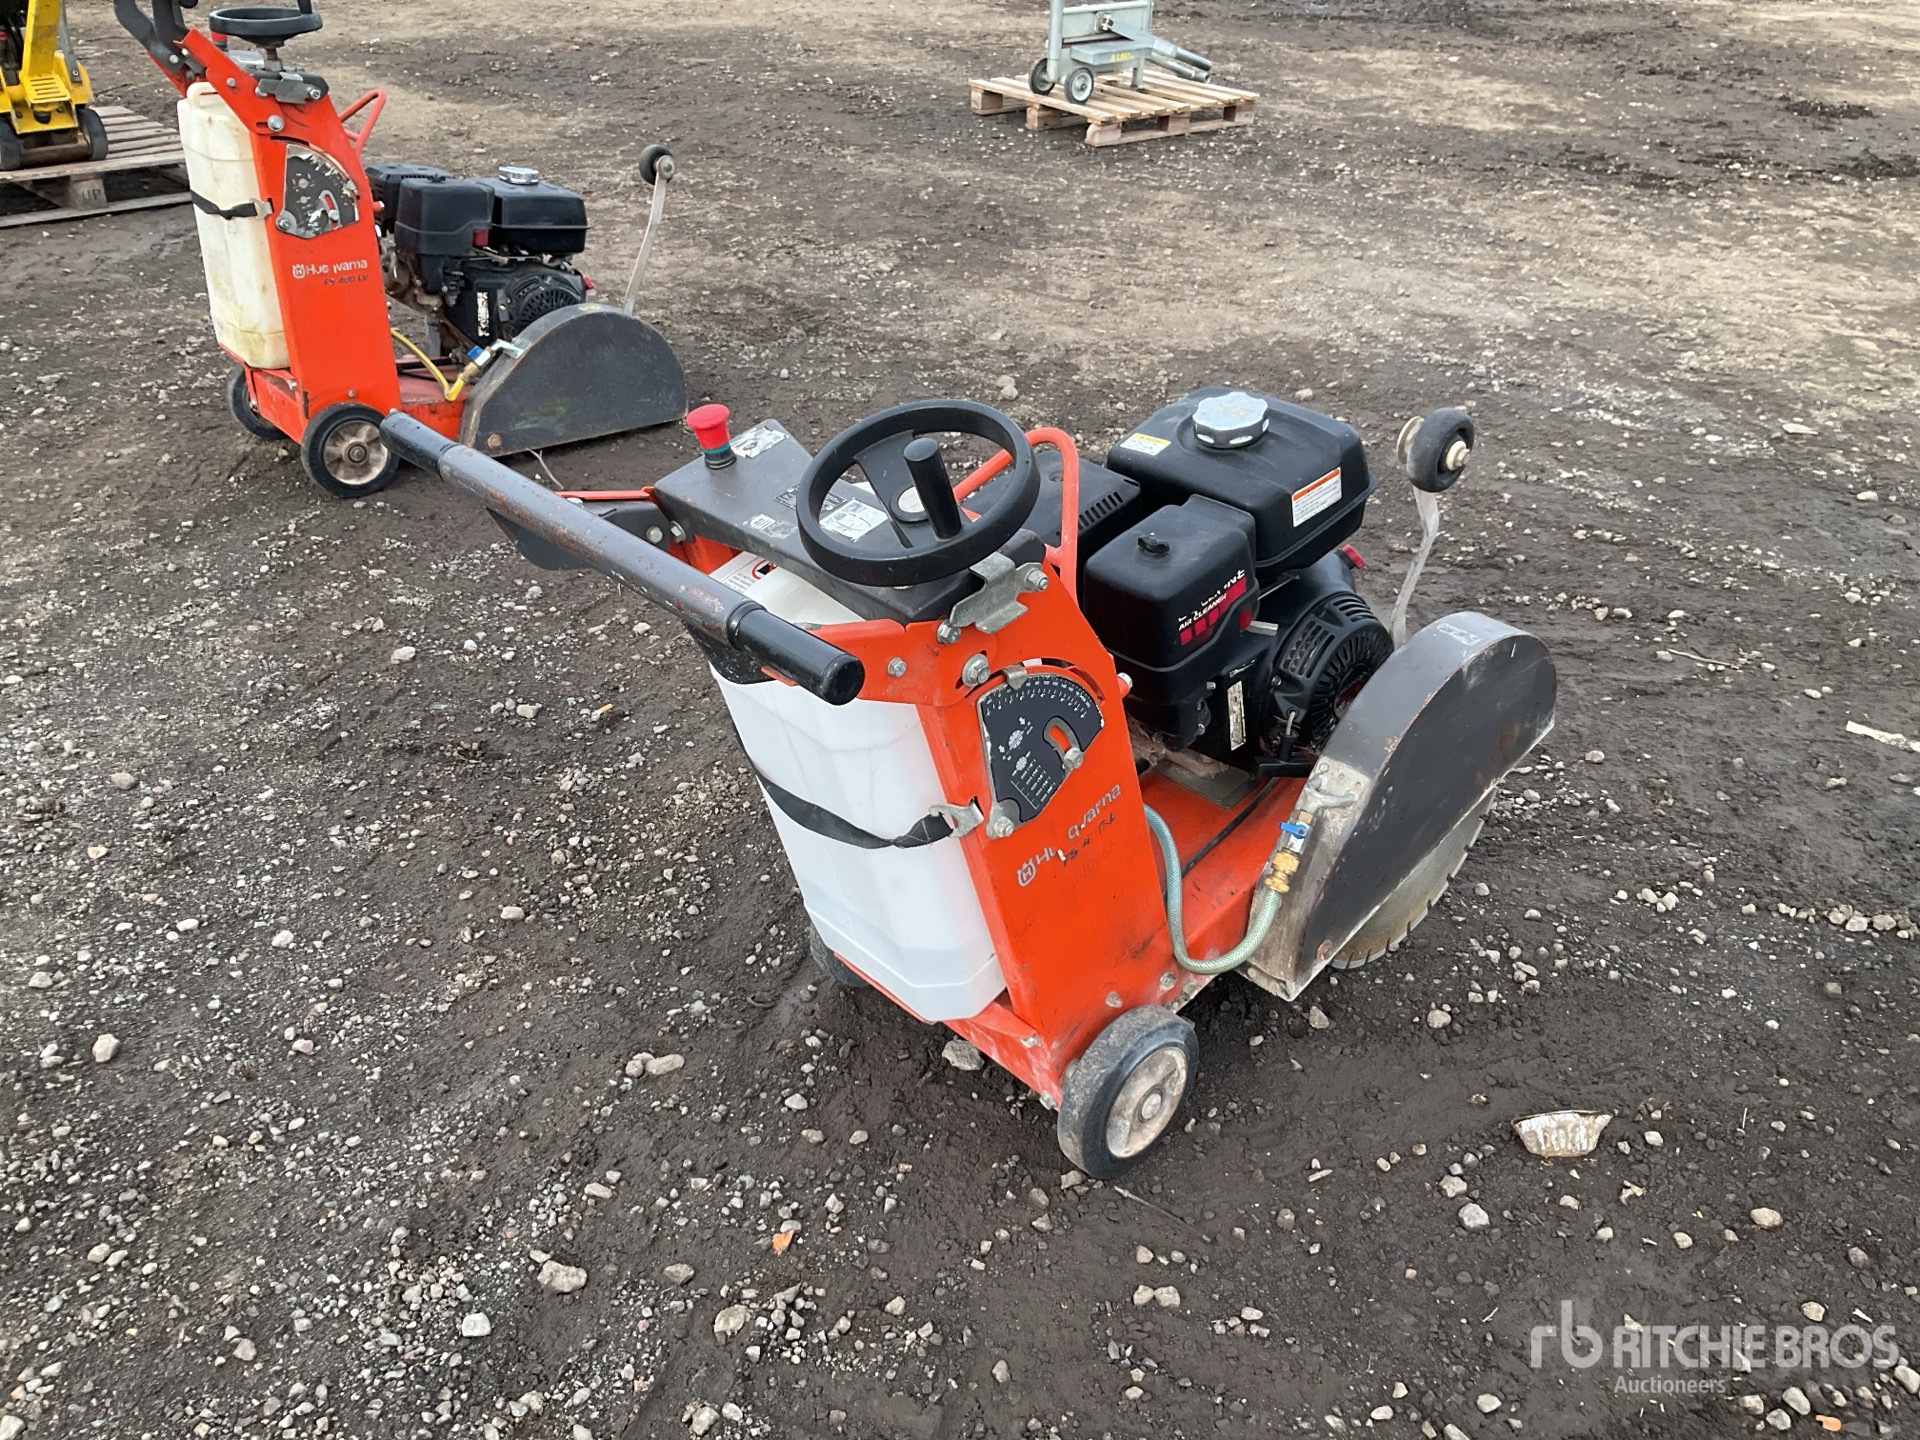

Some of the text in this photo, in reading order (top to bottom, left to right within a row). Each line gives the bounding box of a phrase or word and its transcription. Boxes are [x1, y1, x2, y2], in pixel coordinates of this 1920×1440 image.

[82, 189, 101, 201] UP
[1178, 593, 1227, 631] AIR CLEANER
